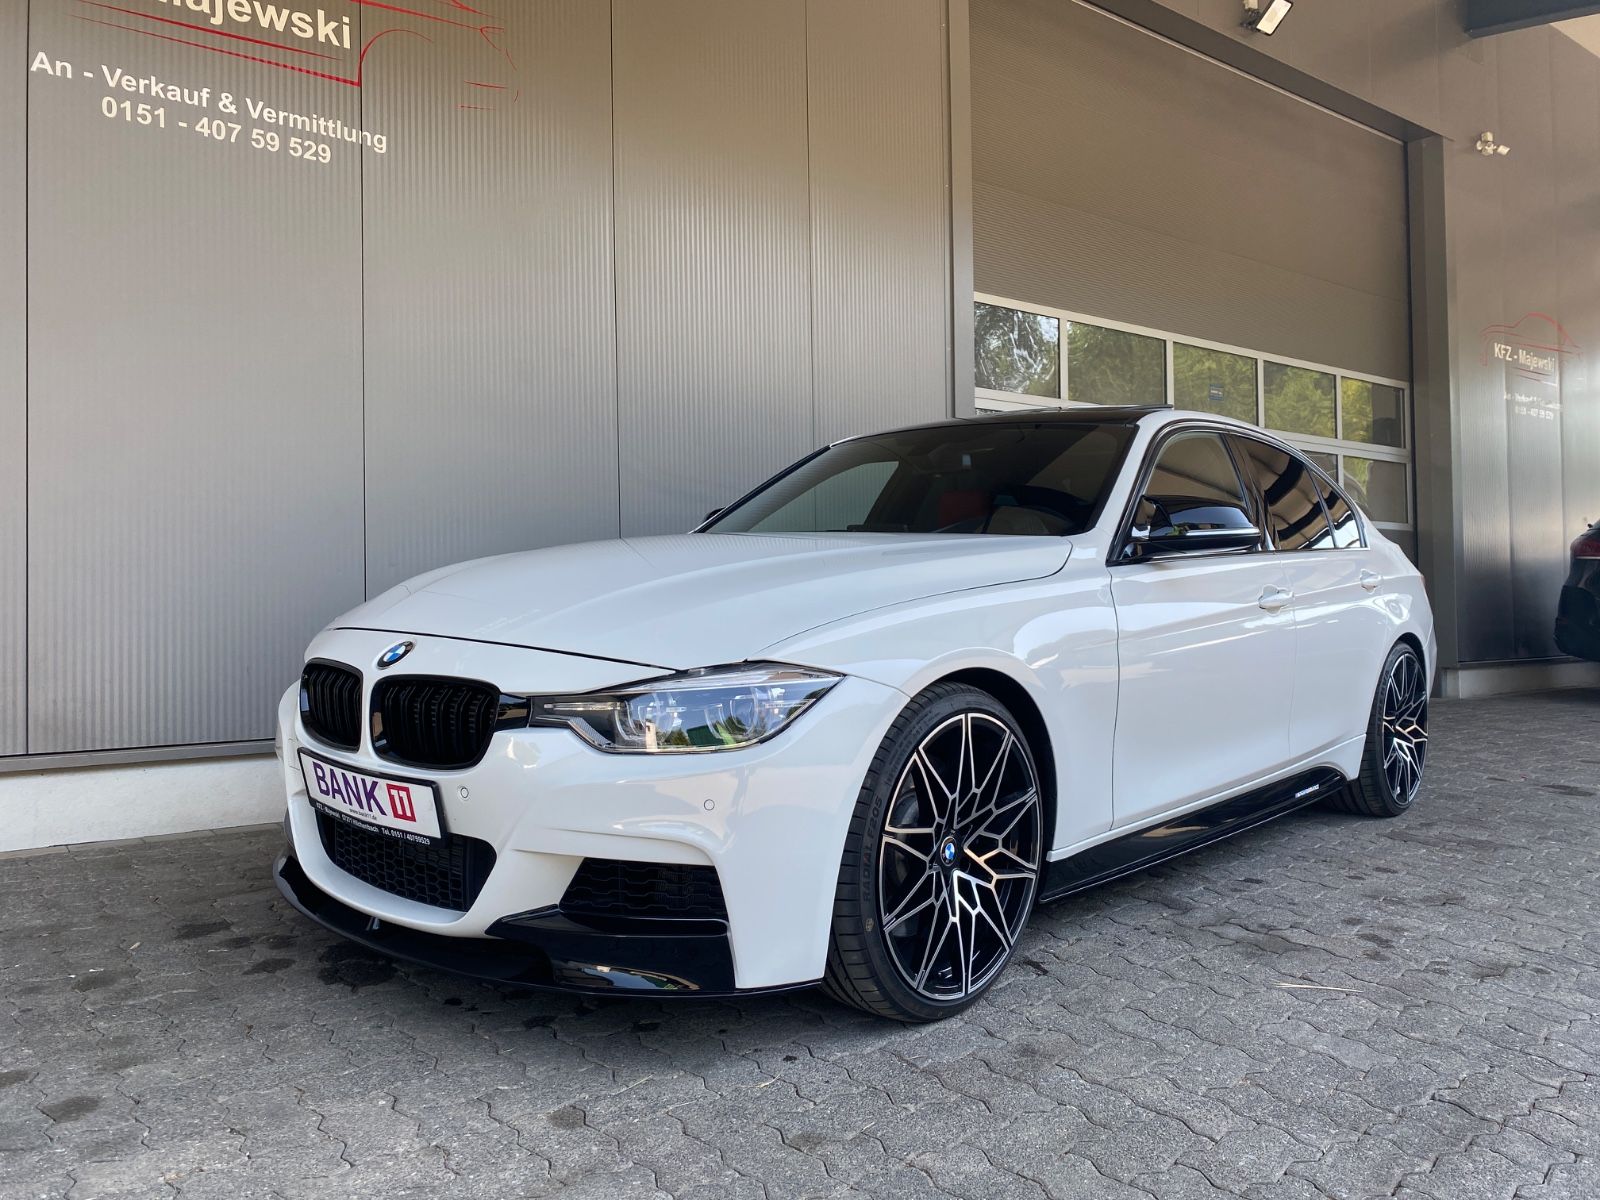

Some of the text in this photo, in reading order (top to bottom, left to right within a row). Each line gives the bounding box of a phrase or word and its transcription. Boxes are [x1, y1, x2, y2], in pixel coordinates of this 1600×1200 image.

[157, 0, 351, 49] ajewski
[30, 51, 73, 79] An
[101, 64, 211, 108] Verkauf
[217, 92, 238, 115] &
[245, 97, 387, 154] Vermittlung
[101, 96, 166, 129] 0151
[194, 116, 242, 143] 407
[250, 128, 280, 152] 59
[288, 136, 332, 164] 529
[1494, 342, 1513, 361] KFZ
[312, 761, 387, 816] BANK
